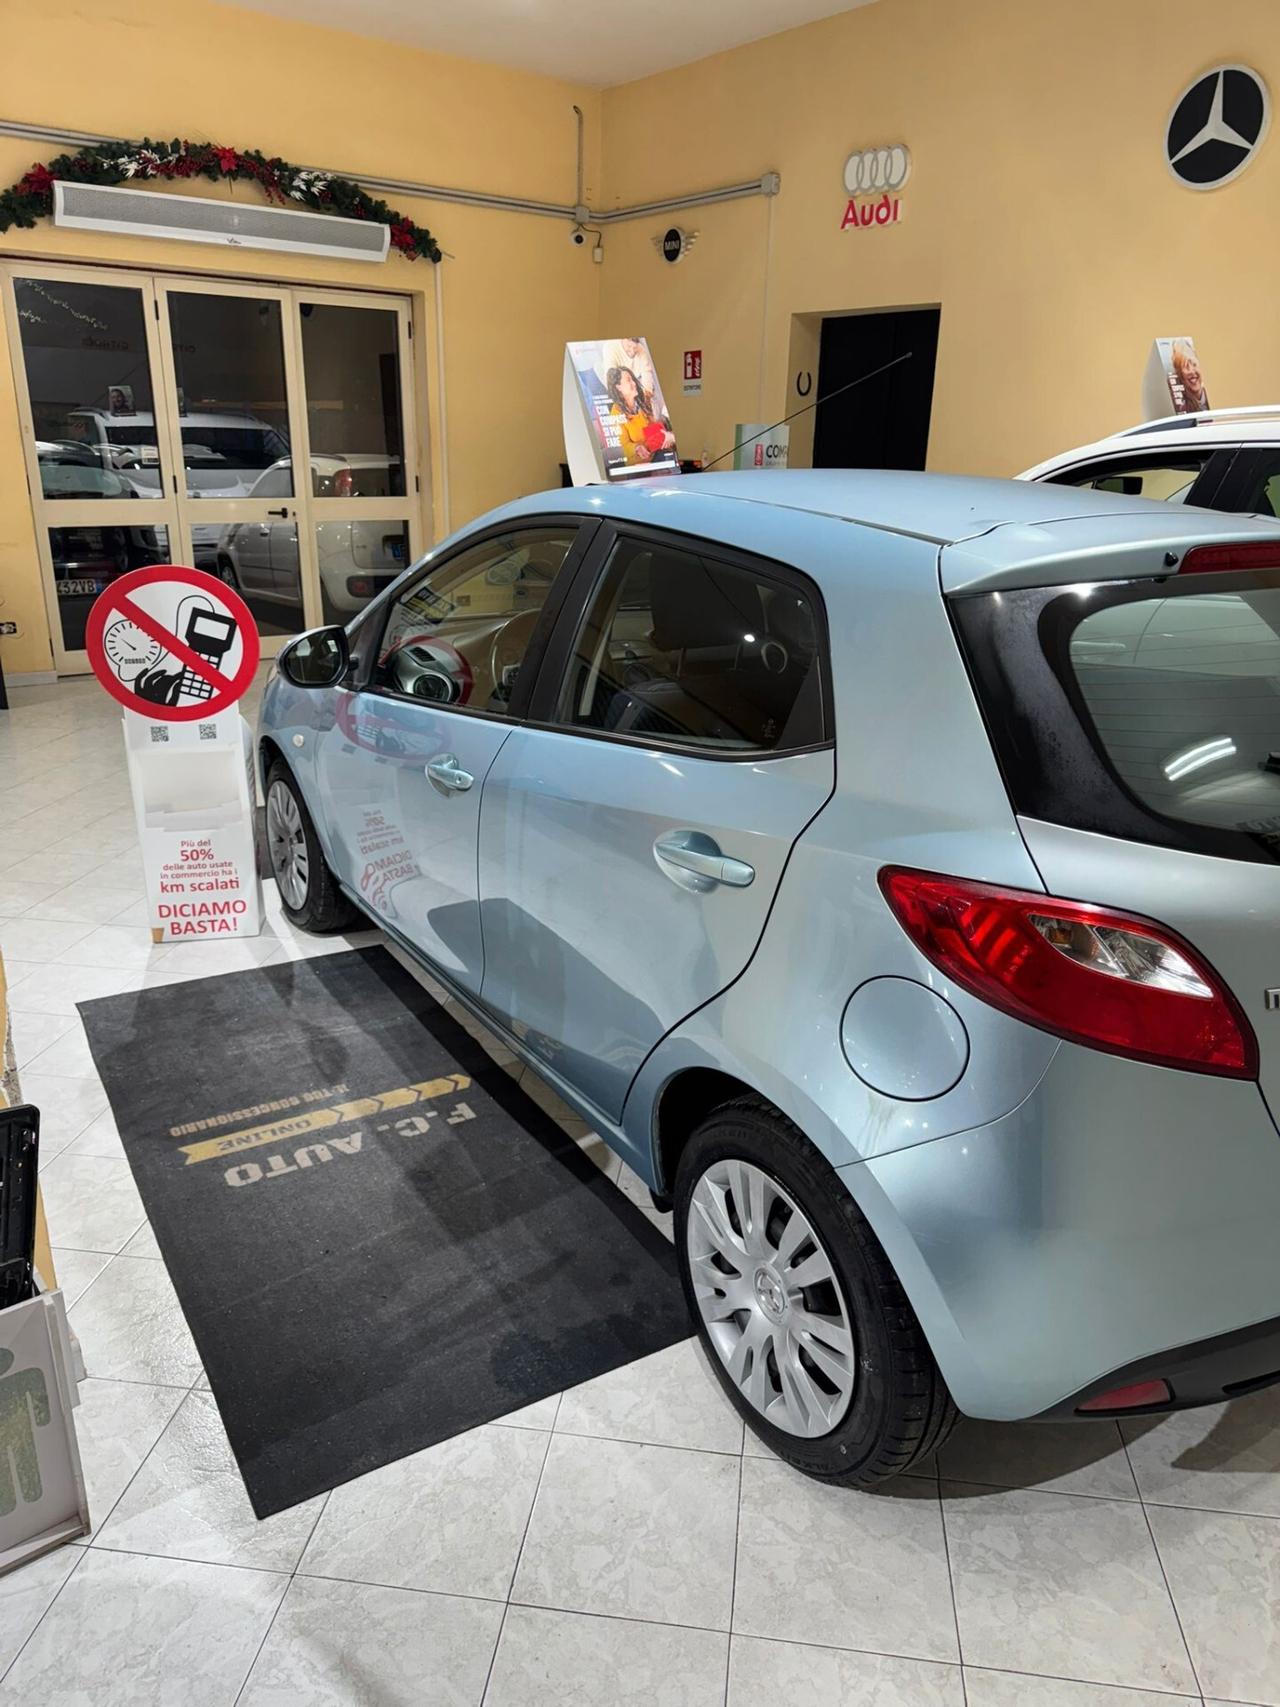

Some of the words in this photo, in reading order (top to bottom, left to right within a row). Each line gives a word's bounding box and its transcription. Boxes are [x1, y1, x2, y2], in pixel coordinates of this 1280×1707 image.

[840, 194, 899, 230] Audi
[665, 240, 680, 251] MINI
[197, 839, 211, 847] del
[180, 848, 214, 861] 50%
[163, 863, 185, 871] delle
[209, 861, 233, 869] usate
[171, 870, 220, 879] commercio
[221, 868, 233, 876] ha
[160, 881, 185, 893] km
[190, 877, 240, 892] scalati
[158, 900, 247, 918] DICIAMO
[170, 917, 238, 935] BASTA!
[170, 1095, 300, 1137] CONCESSIONARIO
[216, 1119, 312, 1150] ONLINE
[223, 1131, 364, 1187] AUTO
